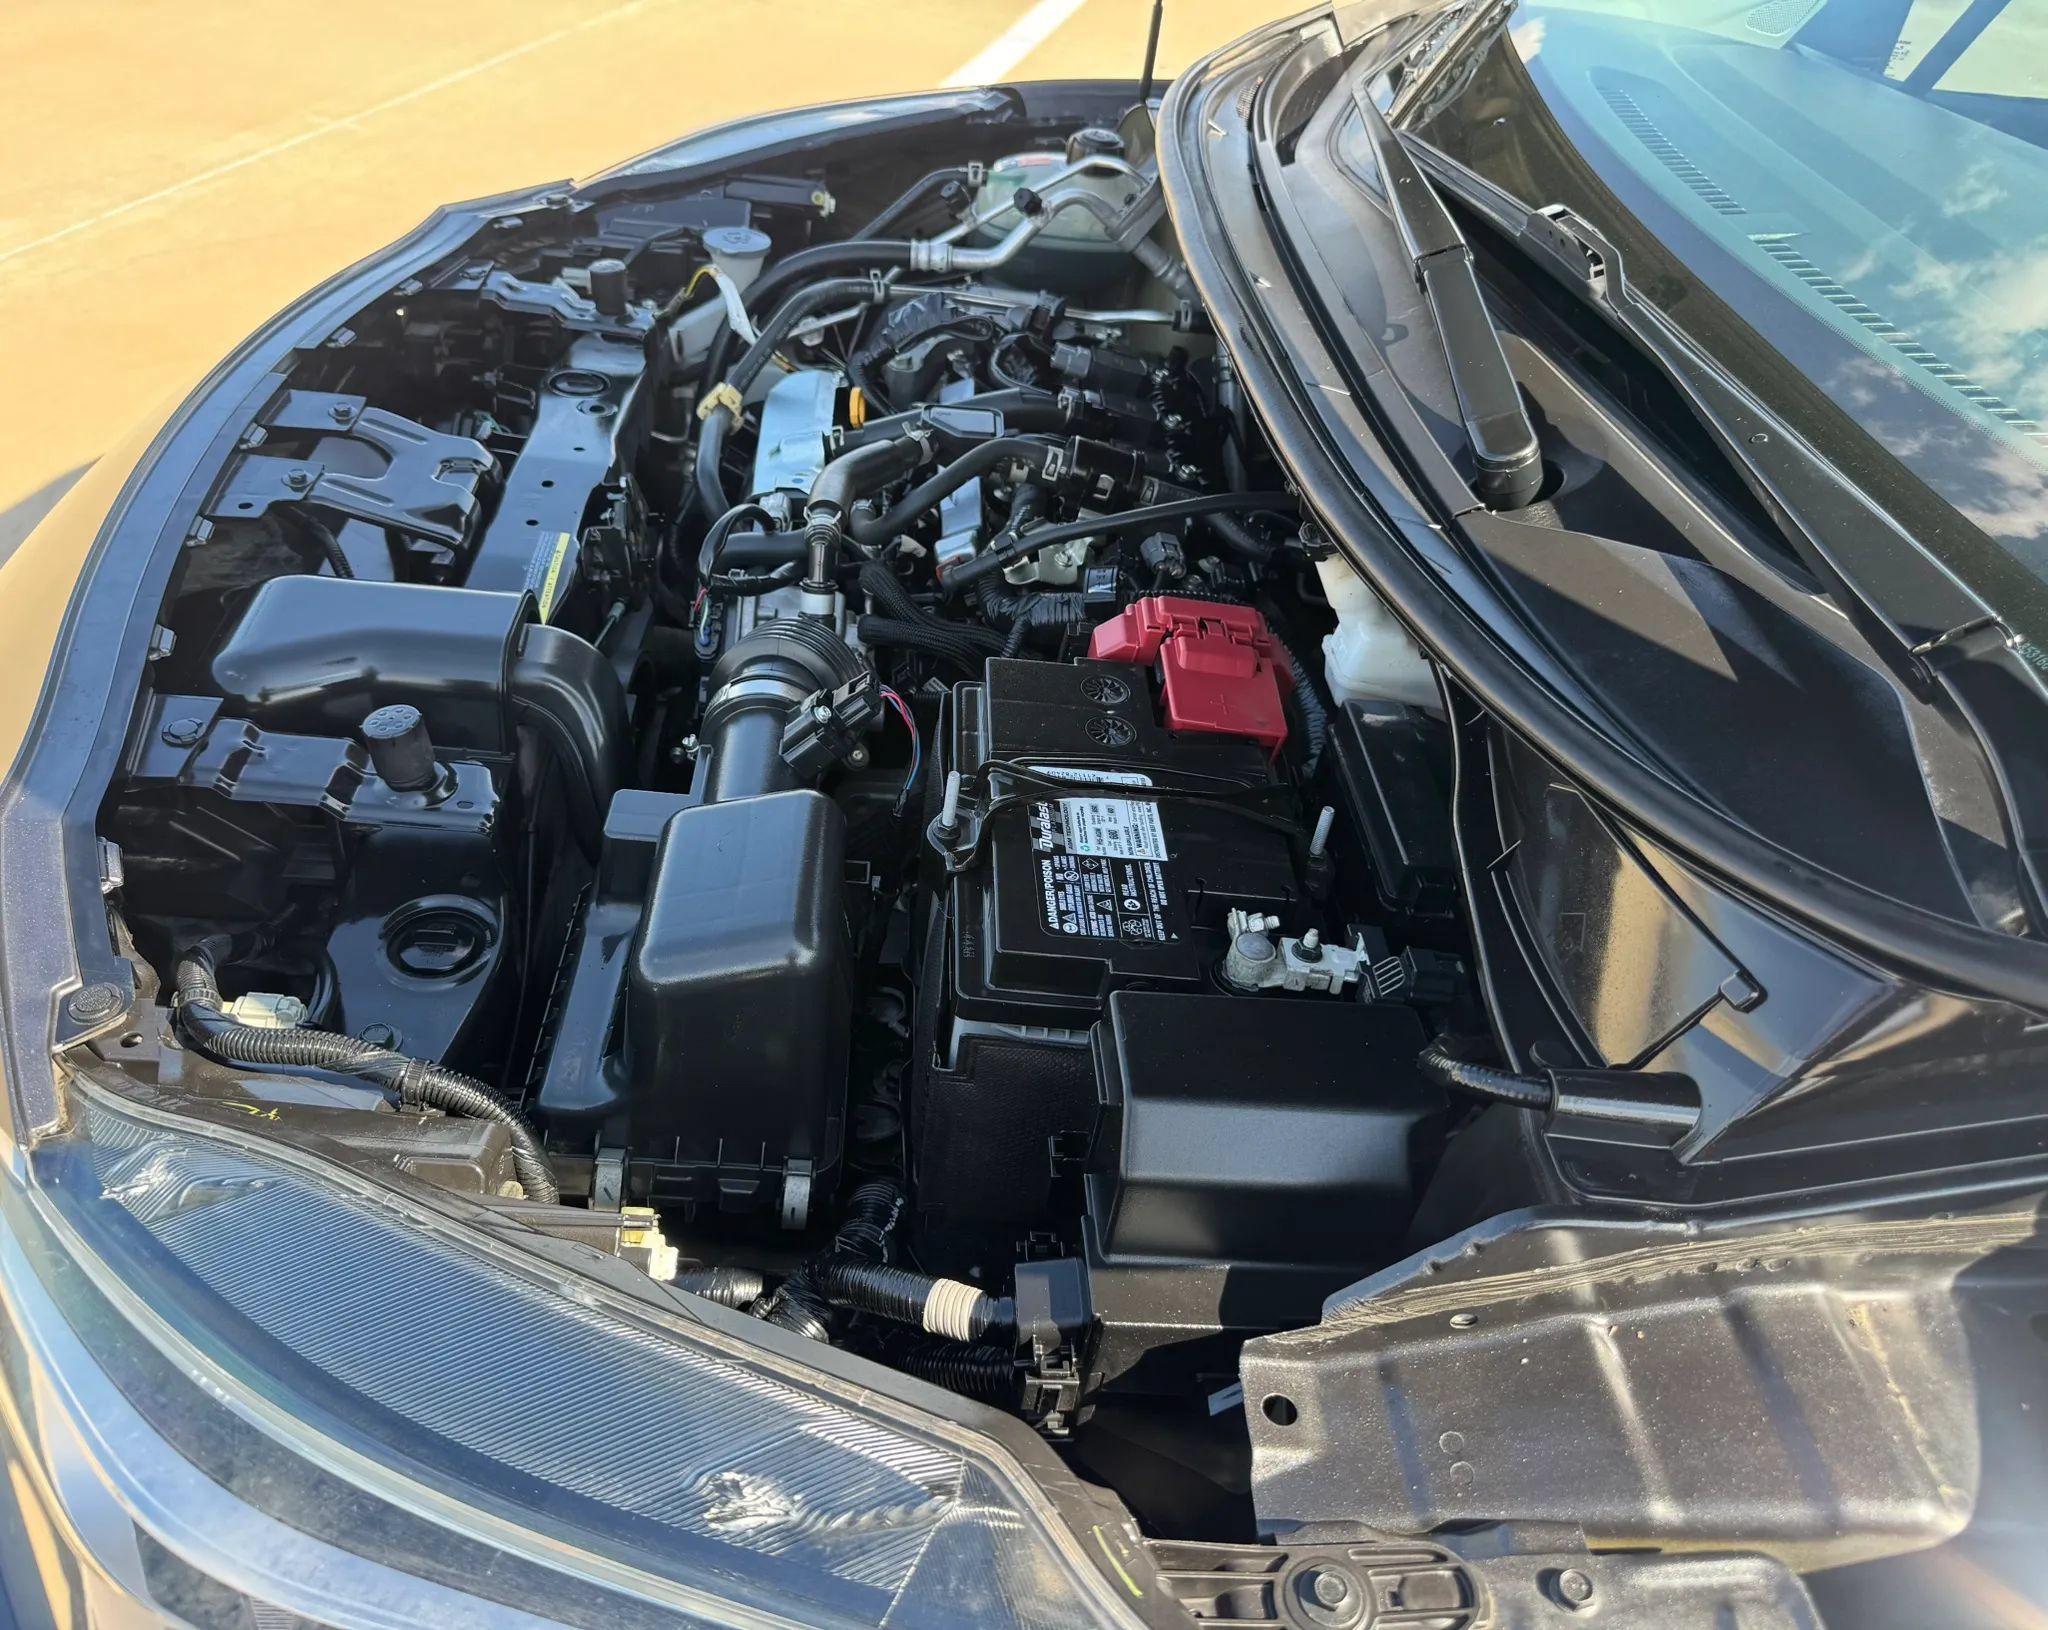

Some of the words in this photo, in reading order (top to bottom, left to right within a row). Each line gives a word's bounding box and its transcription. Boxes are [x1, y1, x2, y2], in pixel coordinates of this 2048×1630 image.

[1035, 802, 1054, 850] Duralast
[1063, 803, 1071, 836] TECHNOLOGY
[1041, 860, 1058, 923] DANGER/POISON
